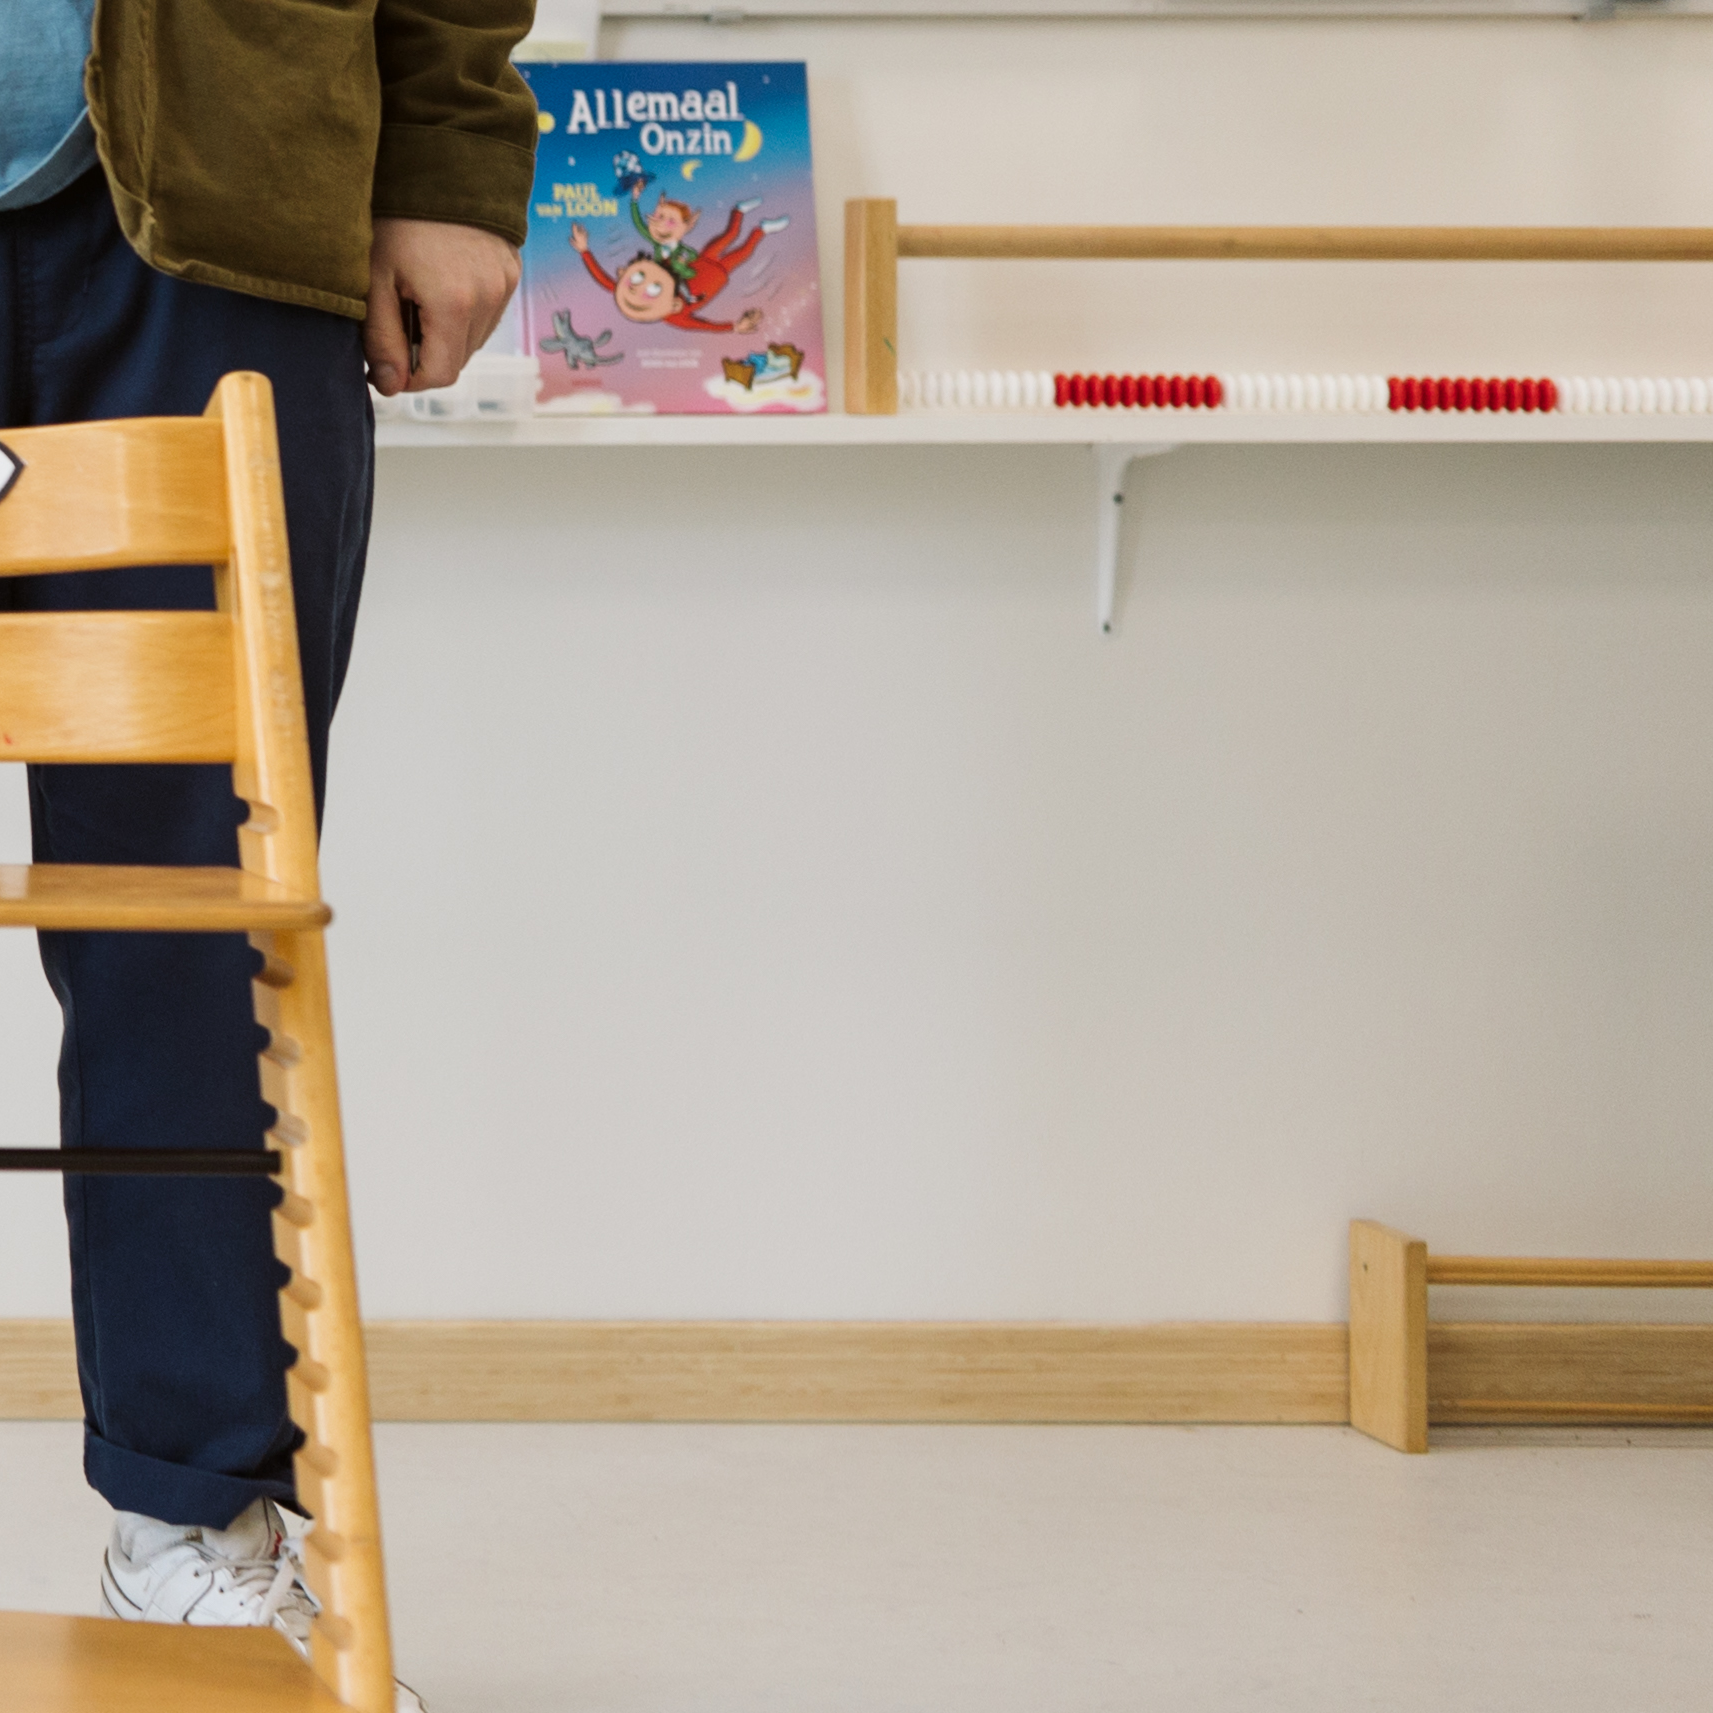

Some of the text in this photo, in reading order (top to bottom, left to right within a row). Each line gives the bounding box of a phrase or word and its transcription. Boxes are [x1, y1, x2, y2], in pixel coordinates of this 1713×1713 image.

[567, 82, 744, 134] Allemaal
[640, 122, 733, 156] Onzin
[552, 183, 601, 200] PAUL
[566, 199, 619, 217] LOON
